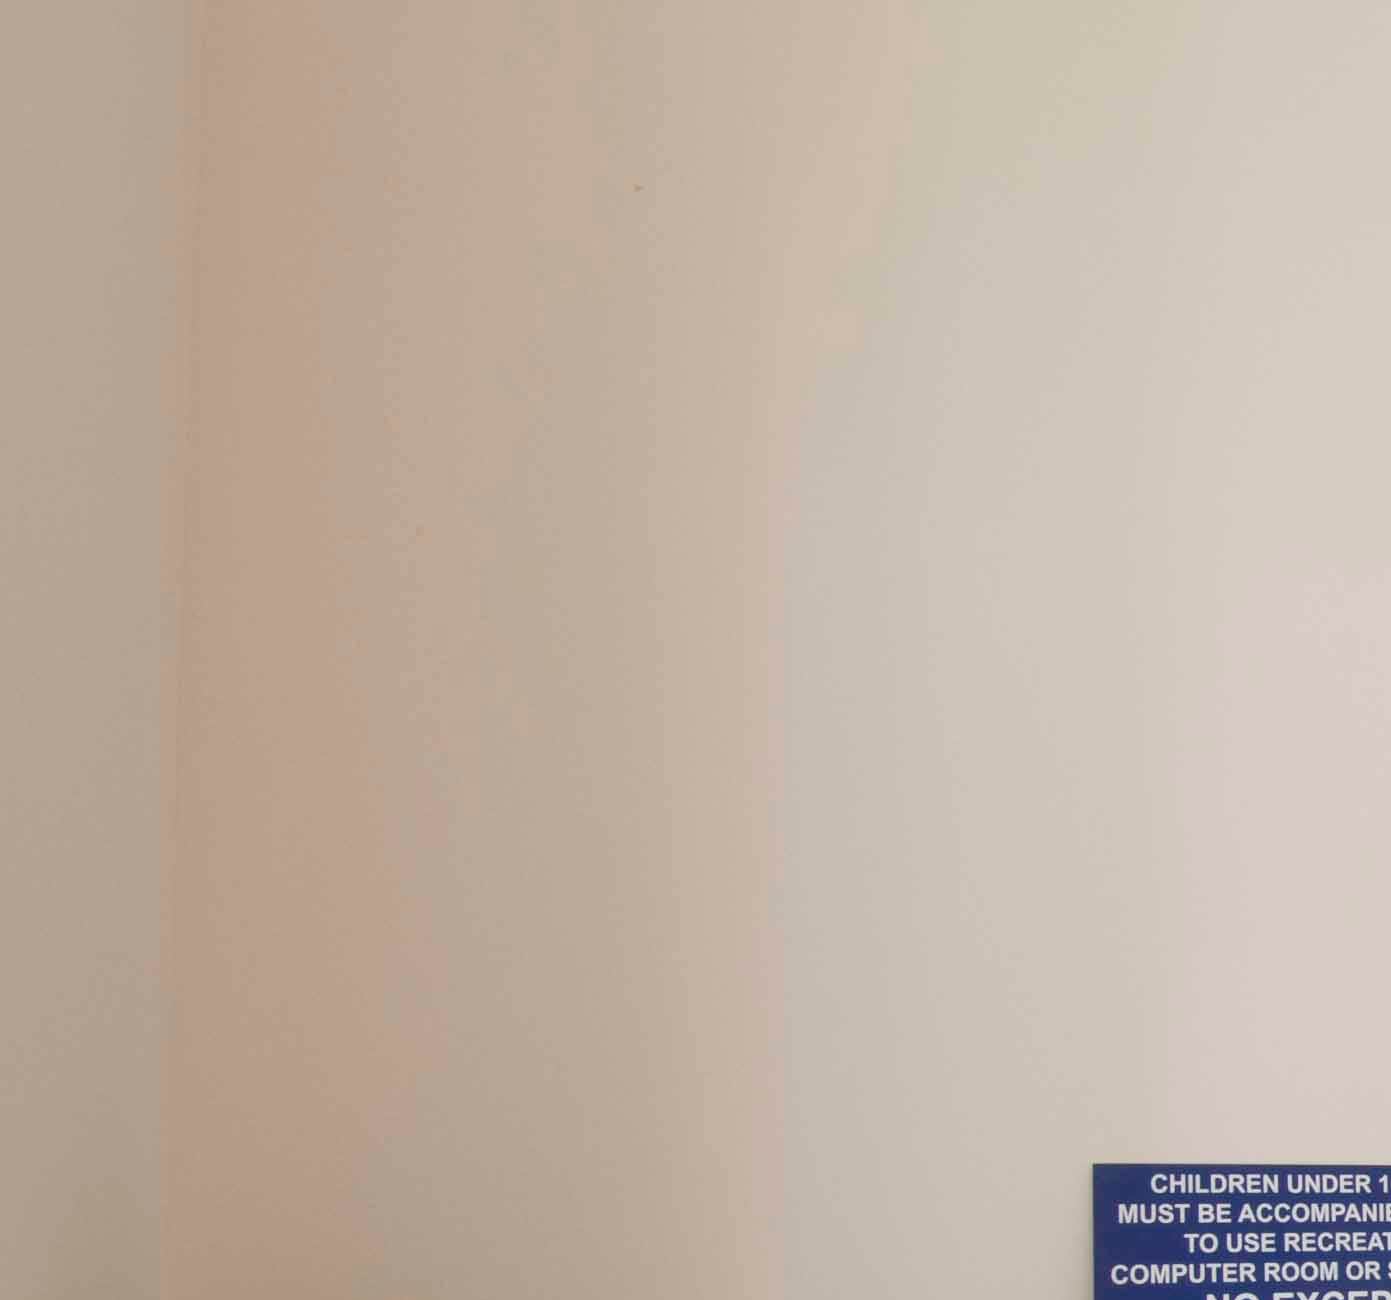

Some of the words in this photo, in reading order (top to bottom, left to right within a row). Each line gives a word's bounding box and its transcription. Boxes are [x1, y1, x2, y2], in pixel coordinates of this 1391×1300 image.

[1150, 1174, 1279, 1194] CHILDREN
[1288, 1174, 1371, 1193] UNDER
[1118, 1204, 1190, 1223] MUST
[1198, 1204, 1232, 1223] BE
[1184, 1233, 1218, 1253] TO
[1227, 1233, 1275, 1252] USE
[1111, 1263, 1256, 1285] COMPUTER
[1264, 1262, 1338, 1282] ROOM
[1346, 1261, 1381, 1281] OR
